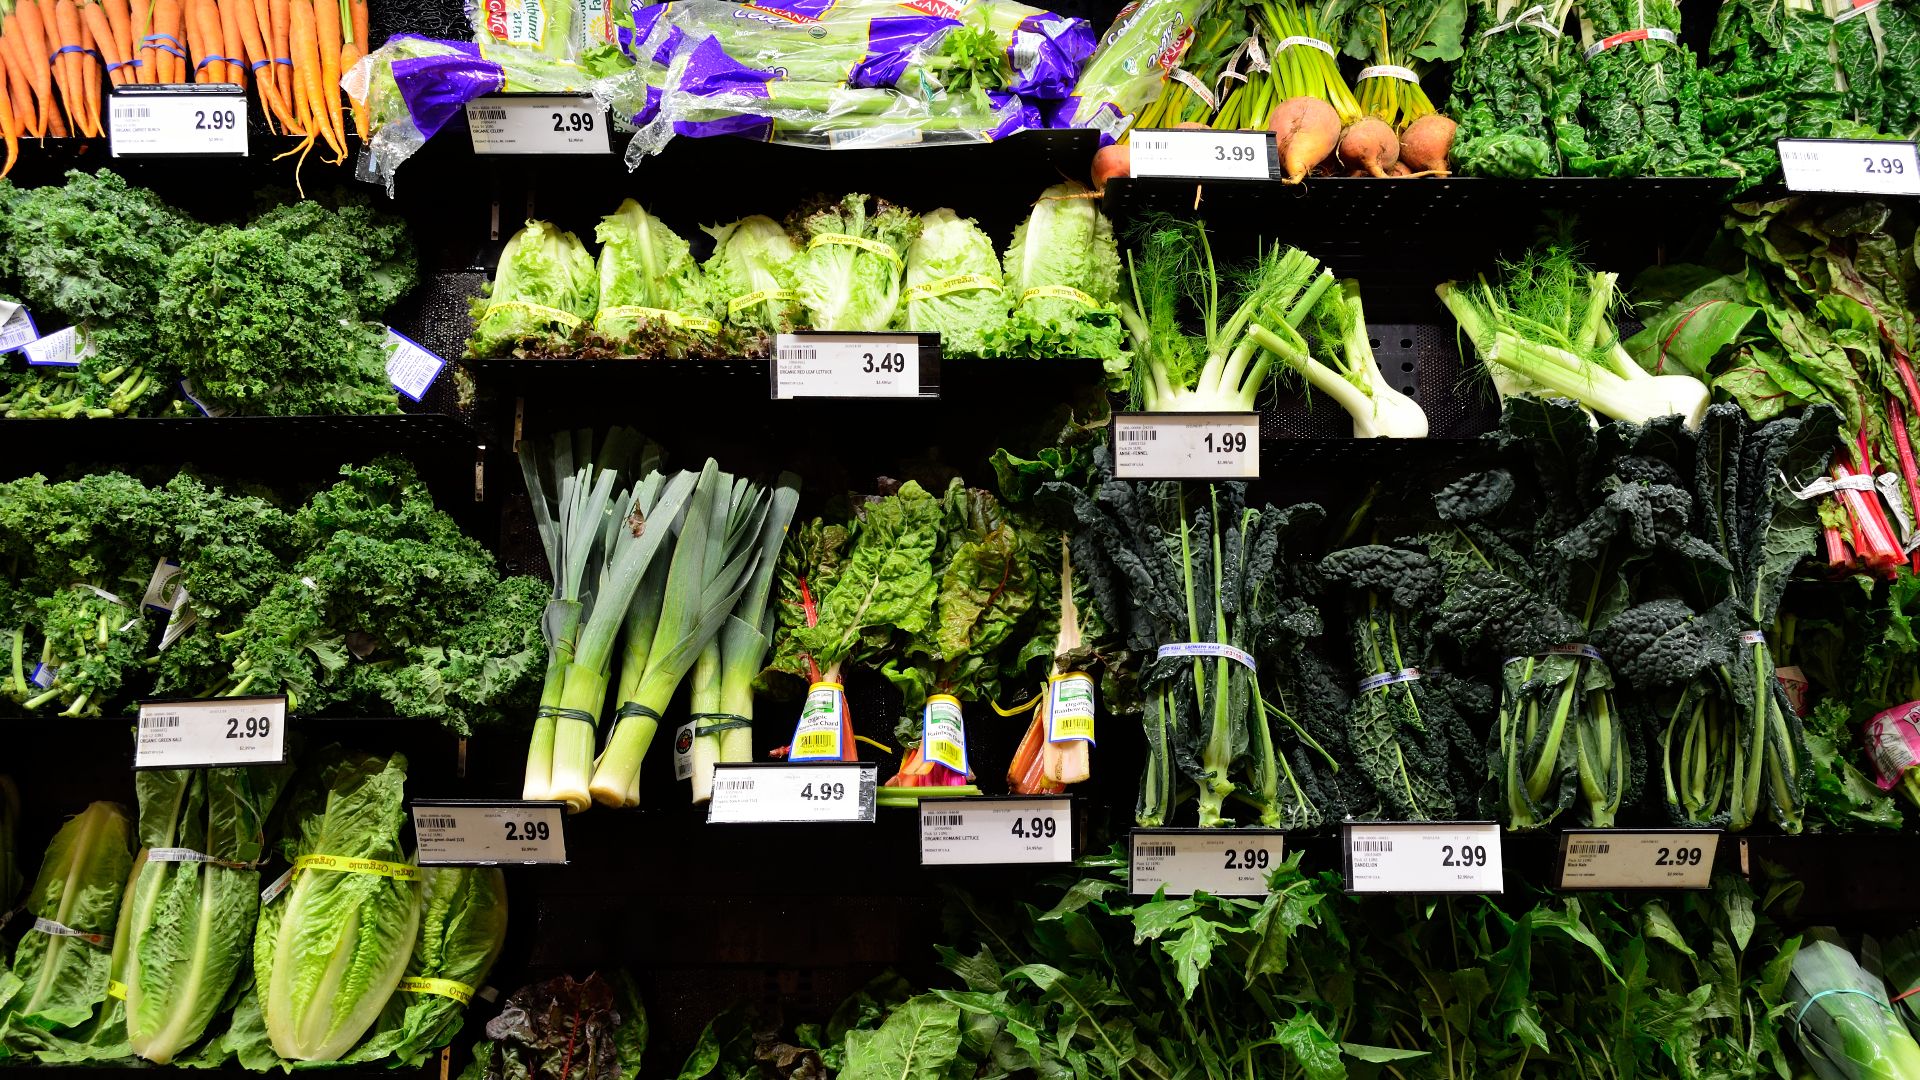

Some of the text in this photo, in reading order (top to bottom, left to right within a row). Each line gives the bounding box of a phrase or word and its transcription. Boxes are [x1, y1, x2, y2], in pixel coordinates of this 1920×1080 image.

[195, 110, 235, 130] 2.99
[551, 112, 594, 132] 2.99
[1214, 146, 1255, 161] 3.99
[1863, 157, 1904, 174] 2.99
[735, 291, 765, 307] Organic
[1052, 288, 1087, 302] Organic
[862, 352, 905, 373] 3.49
[1204, 432, 1247, 453] 1.99
[226, 716, 270, 739] 2.99
[800, 782, 845, 801] 4.99
[505, 821, 550, 841] 2.99
[1011, 817, 1057, 838] 4.99
[1224, 849, 1269, 870] 2.99
[1442, 845, 1487, 867] 2.99
[1655, 847, 1702, 866] 2.99
[349, 861, 389, 873] Organic
